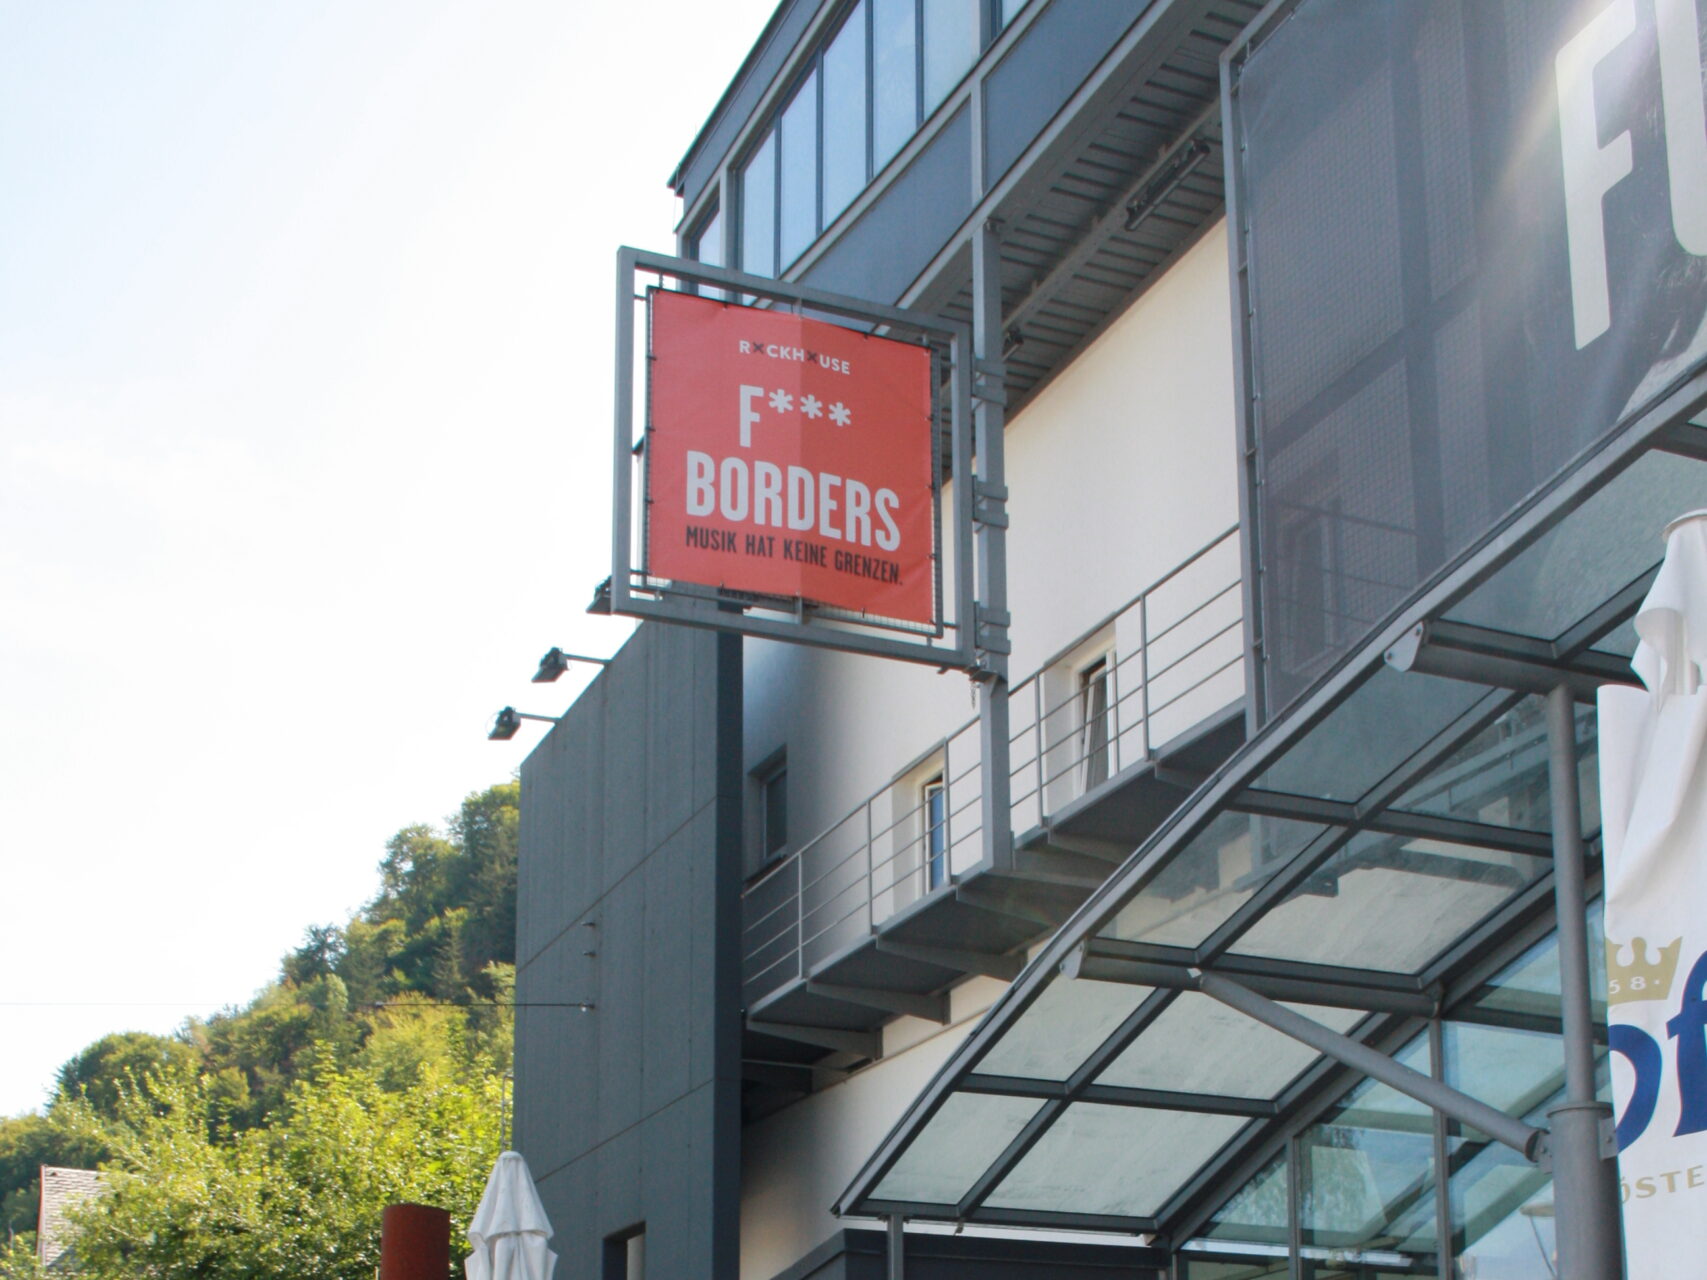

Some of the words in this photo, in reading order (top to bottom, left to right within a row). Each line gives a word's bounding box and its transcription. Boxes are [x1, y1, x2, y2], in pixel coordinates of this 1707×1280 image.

[685, 450, 901, 552] BORDERS
[686, 525, 737, 554] MUSIK
[745, 534, 776, 559] HAT
[783, 538, 828, 569] KEINE
[834, 550, 904, 586] GRENZEN.
